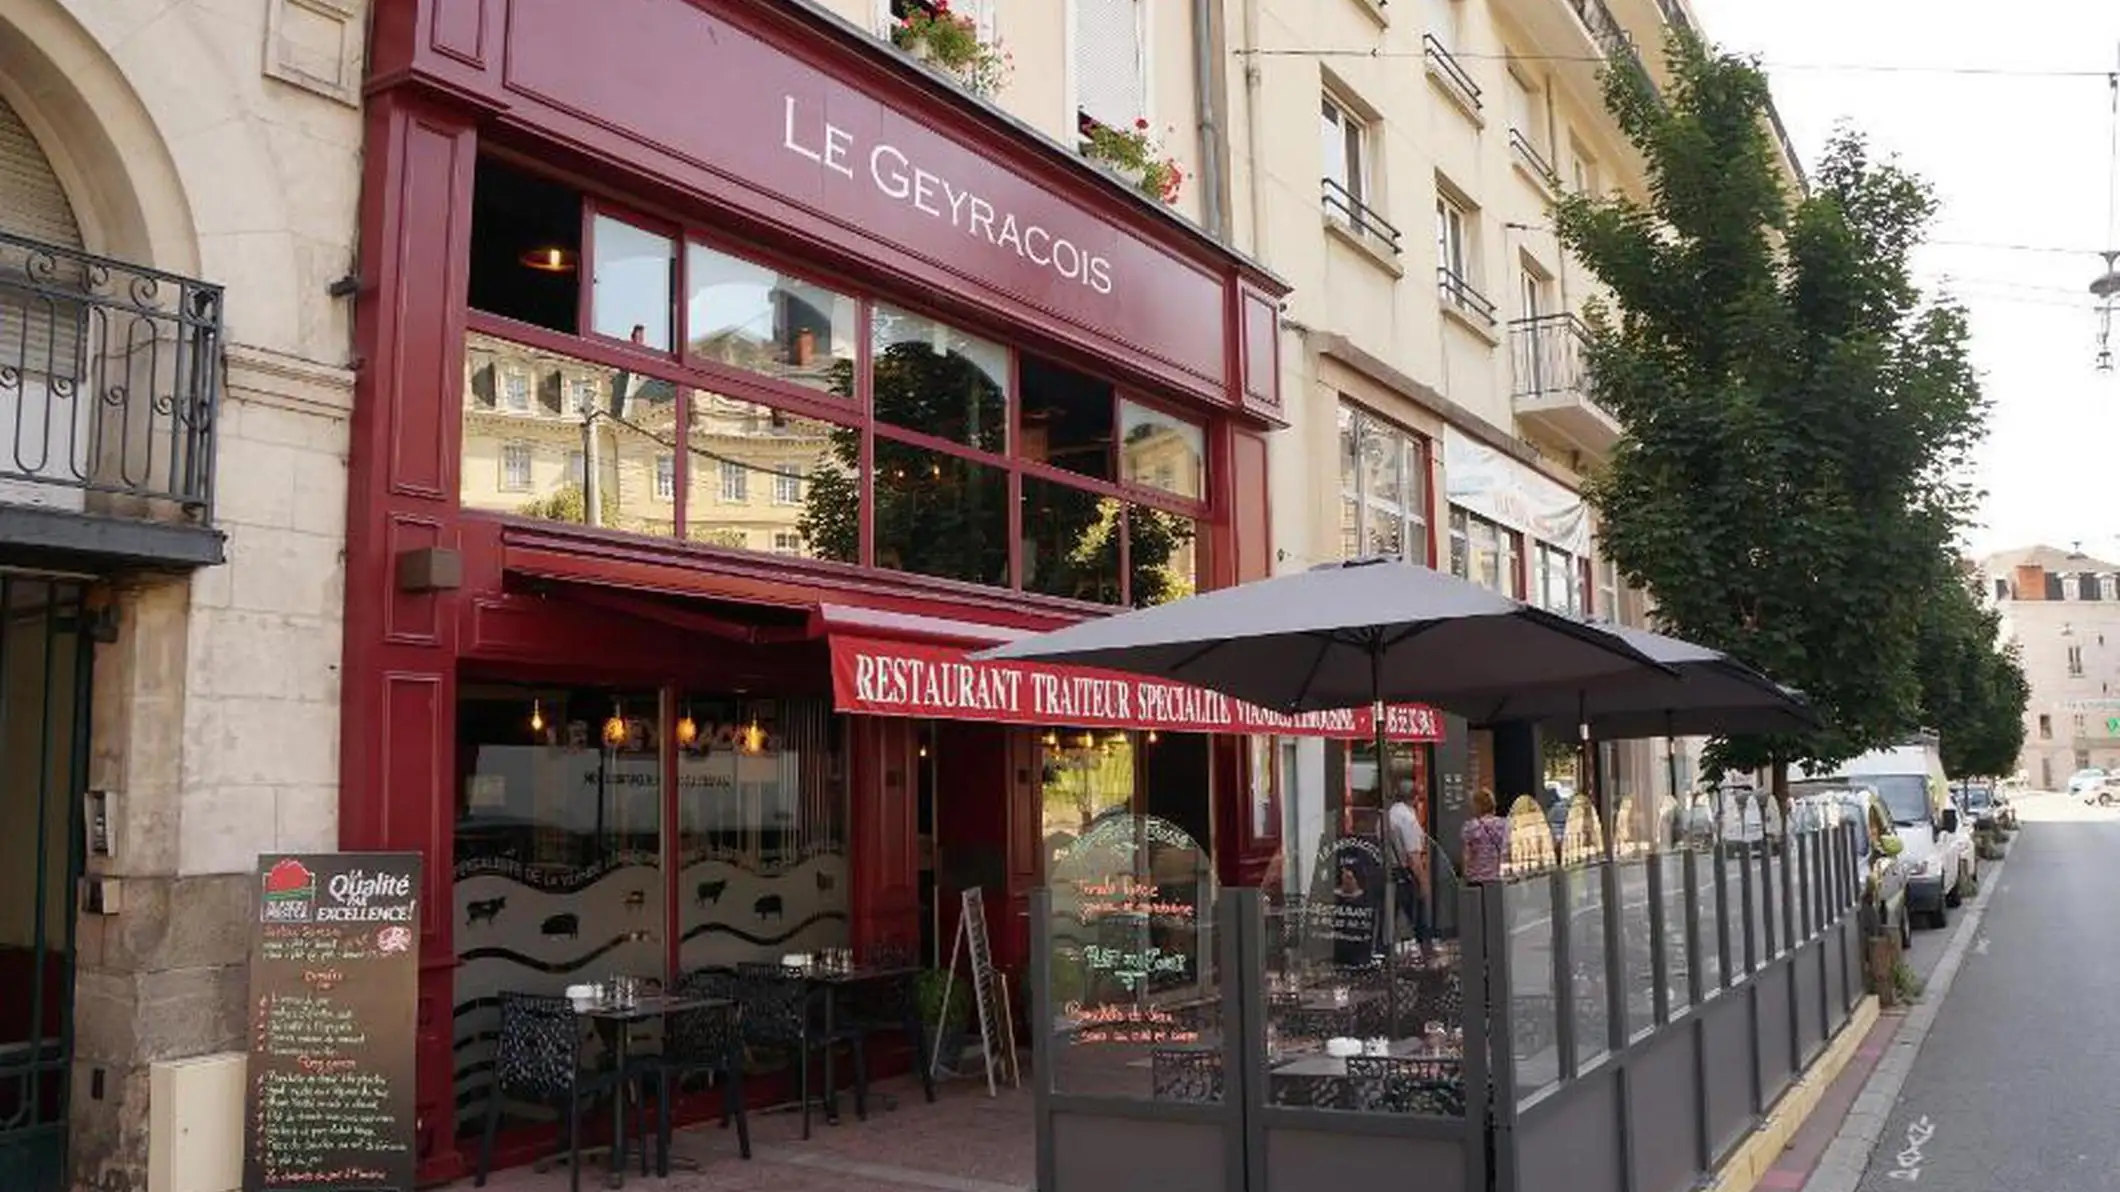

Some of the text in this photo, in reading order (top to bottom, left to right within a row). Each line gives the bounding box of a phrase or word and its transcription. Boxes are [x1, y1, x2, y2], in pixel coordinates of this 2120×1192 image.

[784, 96, 1112, 294] LE GEYRACOIS
[856, 654, 1022, 712] RESTAURANT
[1031, 672, 1130, 720] TRAITEUR
[328, 872, 411, 904] Qualité
